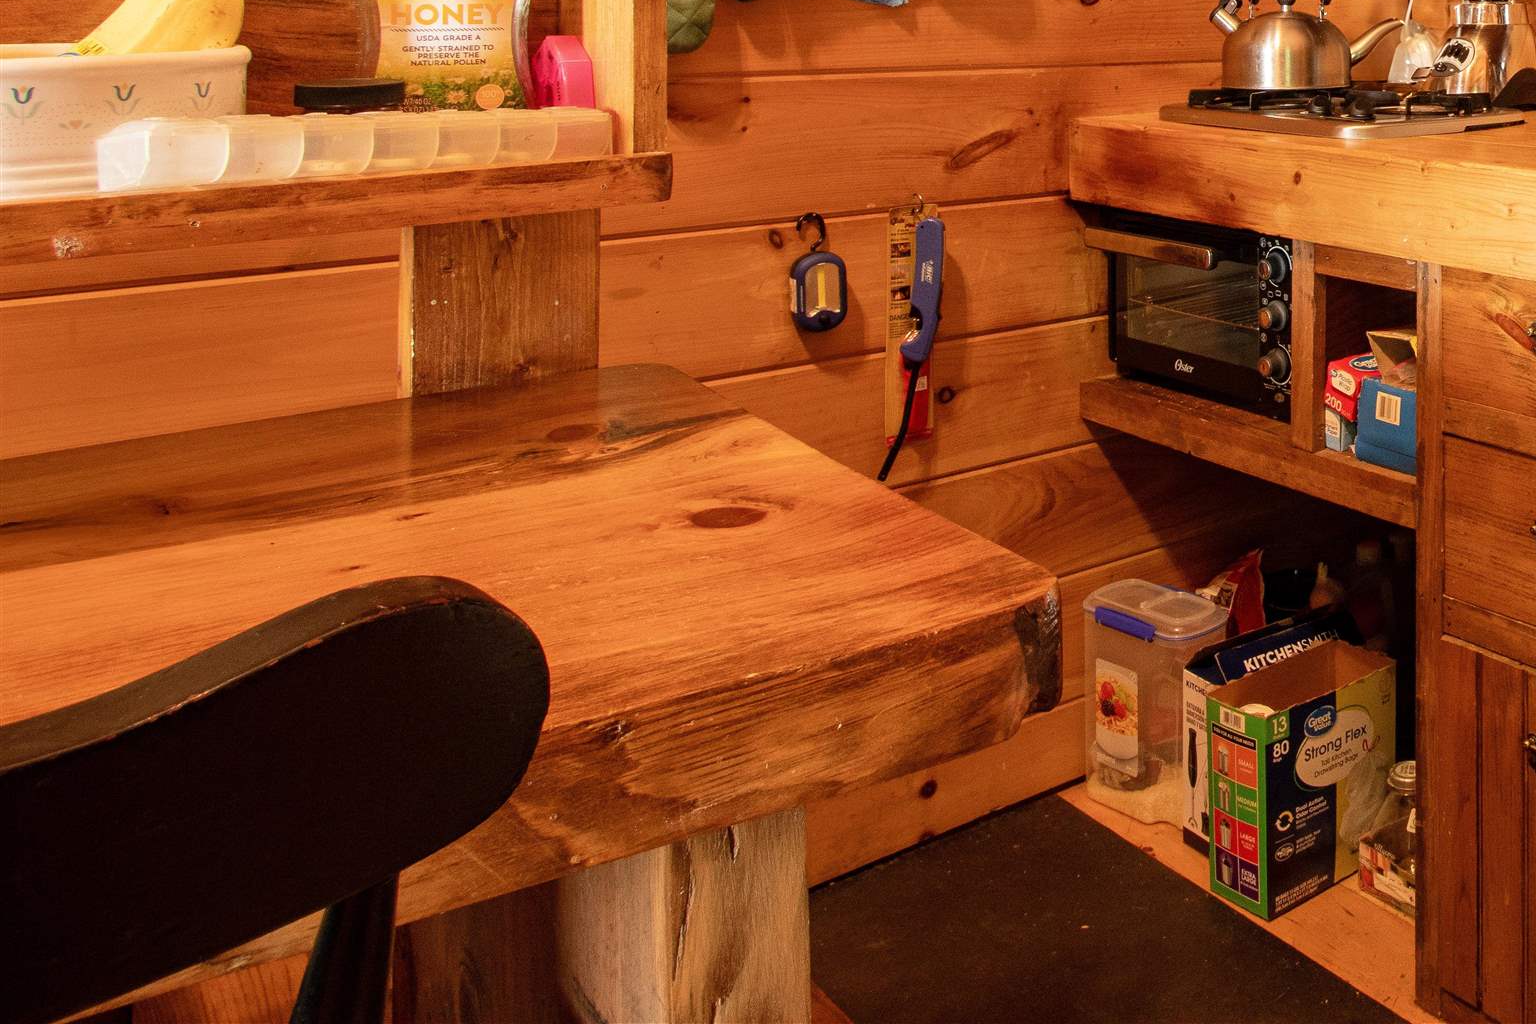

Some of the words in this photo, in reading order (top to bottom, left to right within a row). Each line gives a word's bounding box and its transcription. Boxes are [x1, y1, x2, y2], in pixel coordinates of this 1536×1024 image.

[390, 3, 505, 26] HONEY
[442, 34, 473, 42] GRADE
[402, 45, 436, 53] GENTLY
[453, 58, 487, 66] POLLEN
[889, 313, 911, 321] DANGE
[1174, 358, 1195, 374] Oster
[1324, 393, 1342, 412] 200
[1185, 680, 1208, 696] KITCHE
[1272, 716, 1288, 735] 13
[1308, 711, 1331, 728] Great
[1272, 739, 1290, 759] 80
[1304, 737, 1342, 762] Strong
[1345, 725, 1368, 744] Flex
